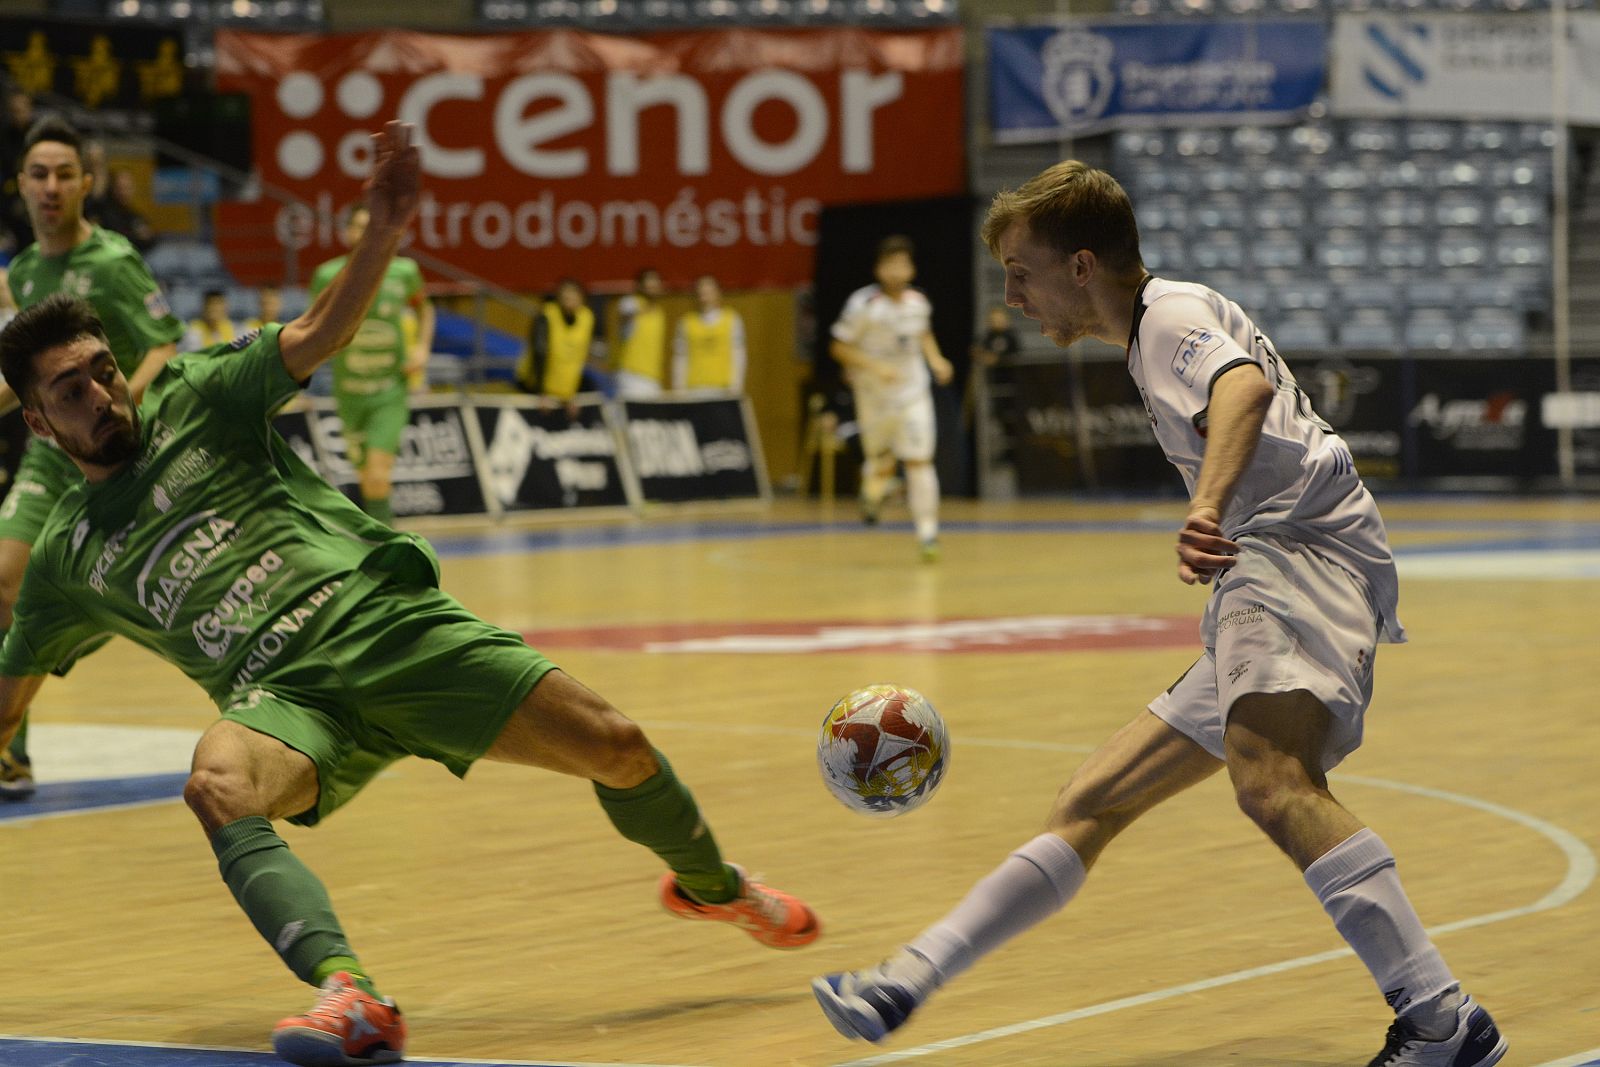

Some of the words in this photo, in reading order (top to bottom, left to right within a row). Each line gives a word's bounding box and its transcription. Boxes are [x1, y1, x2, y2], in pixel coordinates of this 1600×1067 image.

[397, 70, 904, 179] cenor
[274, 187, 822, 249] eltrodoméstic
[148, 516, 236, 626] MAGNA
